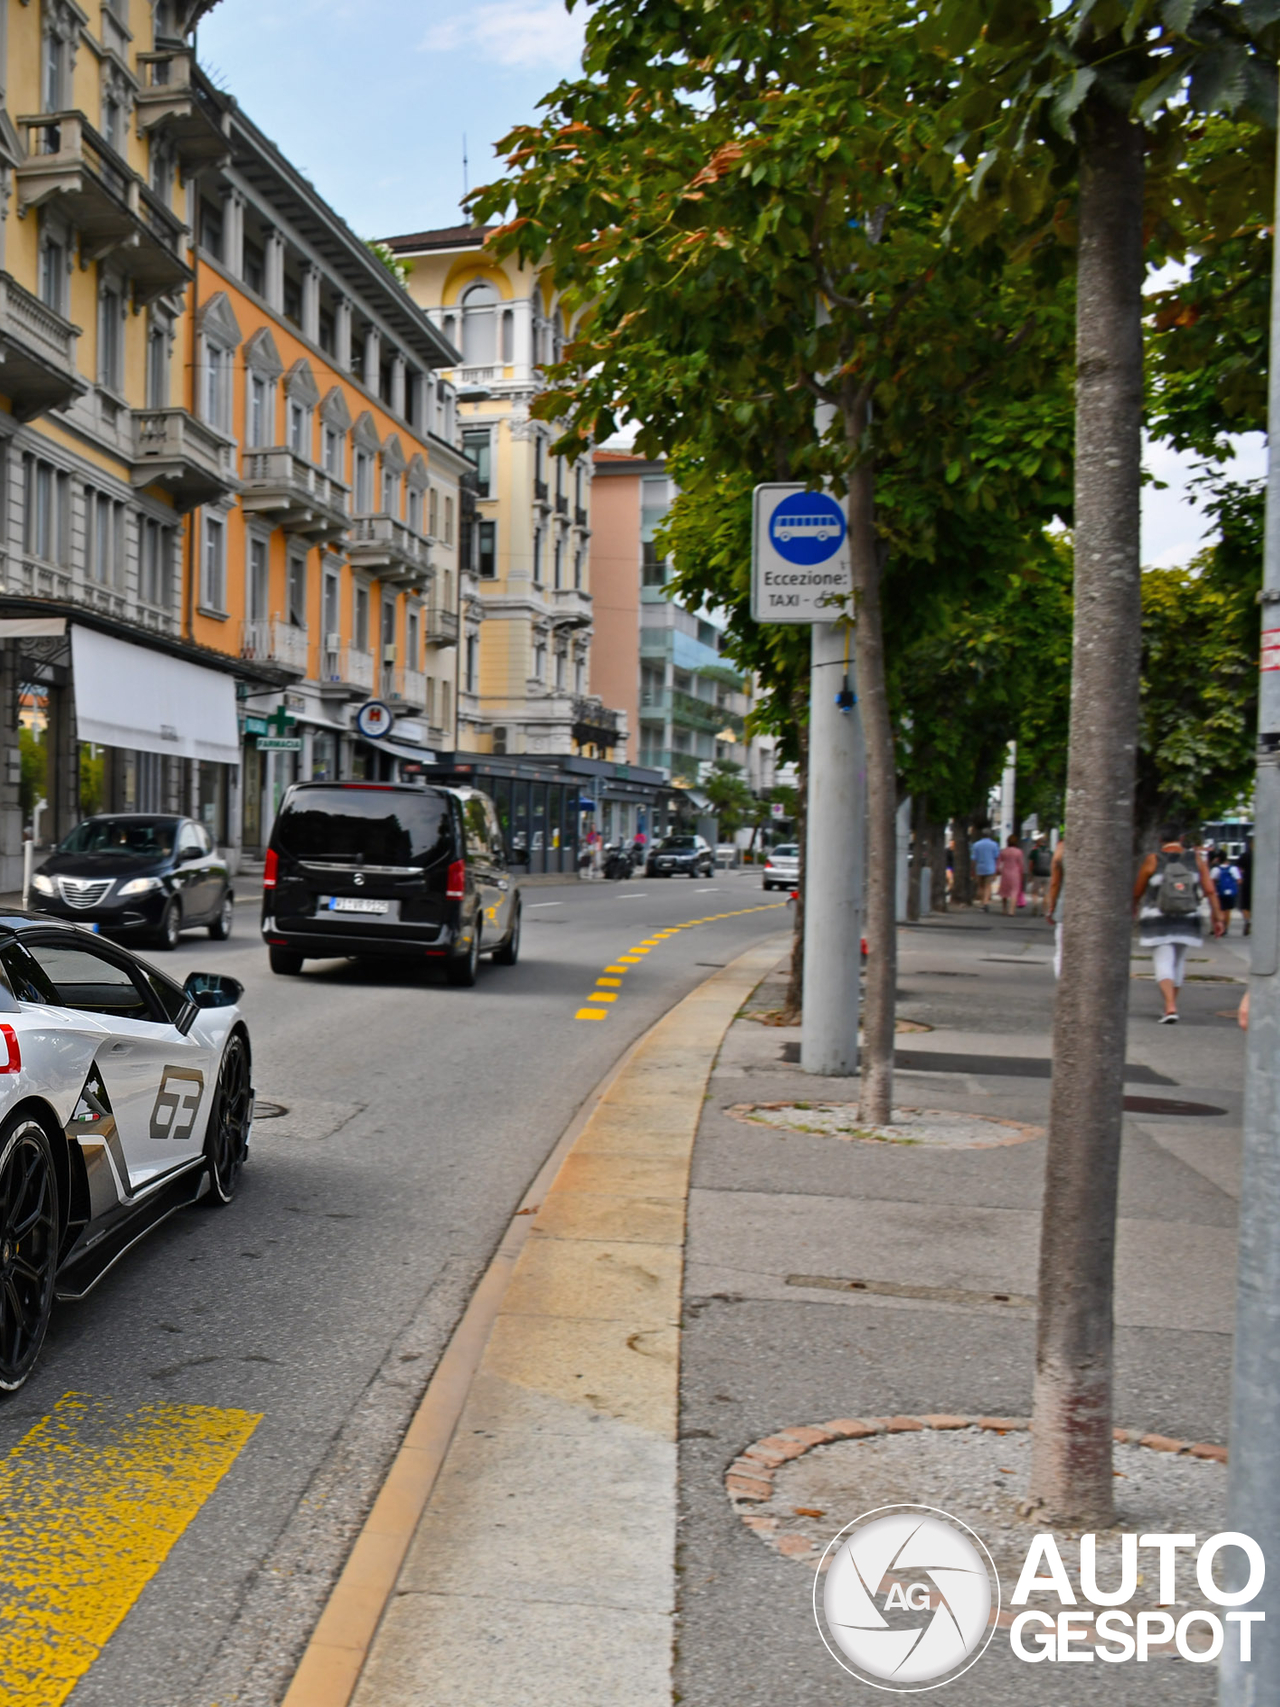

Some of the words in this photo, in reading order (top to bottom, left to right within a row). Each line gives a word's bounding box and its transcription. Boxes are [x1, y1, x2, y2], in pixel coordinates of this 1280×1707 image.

[764, 570, 848, 586] Eccezione:
[768, 594, 800, 607] TAXI
[257, 739, 301, 749] FARMACIA
[150, 1064, 204, 1140] 63
